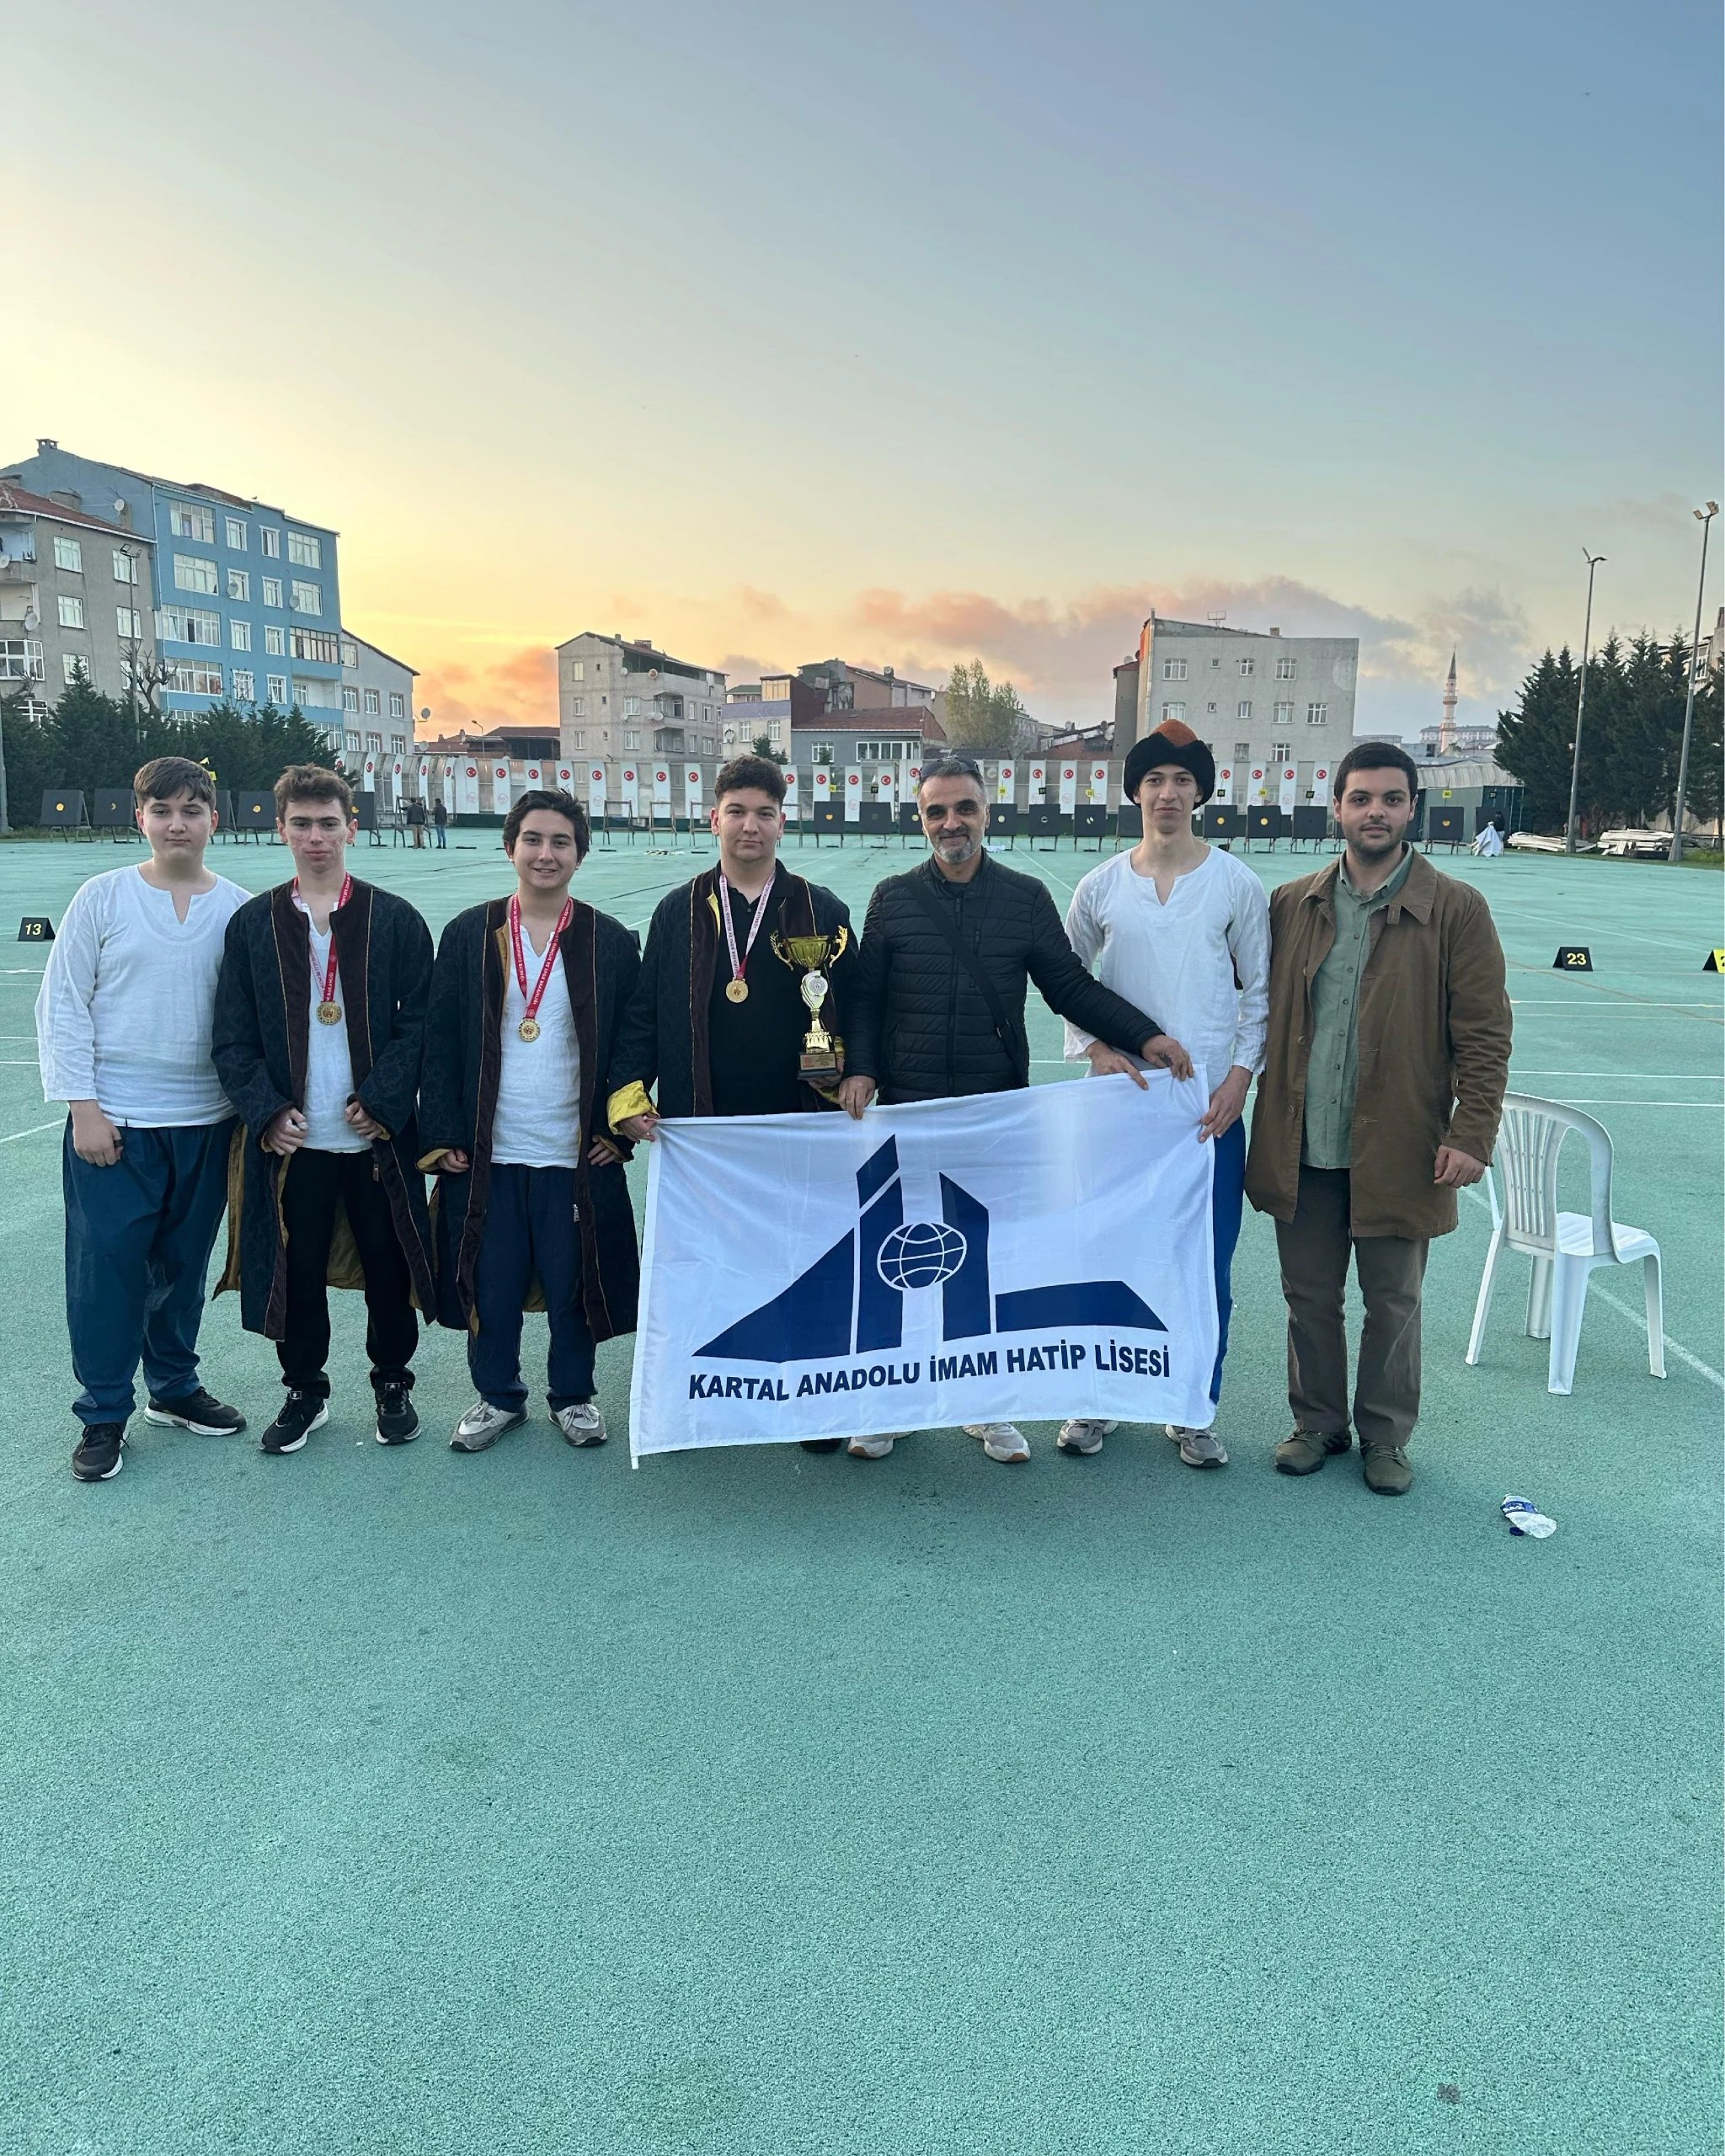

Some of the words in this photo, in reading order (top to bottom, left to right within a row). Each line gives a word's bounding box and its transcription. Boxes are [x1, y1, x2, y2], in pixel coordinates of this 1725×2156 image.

[25, 923, 42, 936] 13
[1567, 953, 1587, 966] 23
[689, 1374, 790, 1401] KARTAL
[796, 1362, 920, 1397] ANADOLU
[929, 1351, 998, 1382] İMAM
[1007, 1339, 1087, 1373] HATİP
[1094, 1339, 1170, 1378] LİSESİ
